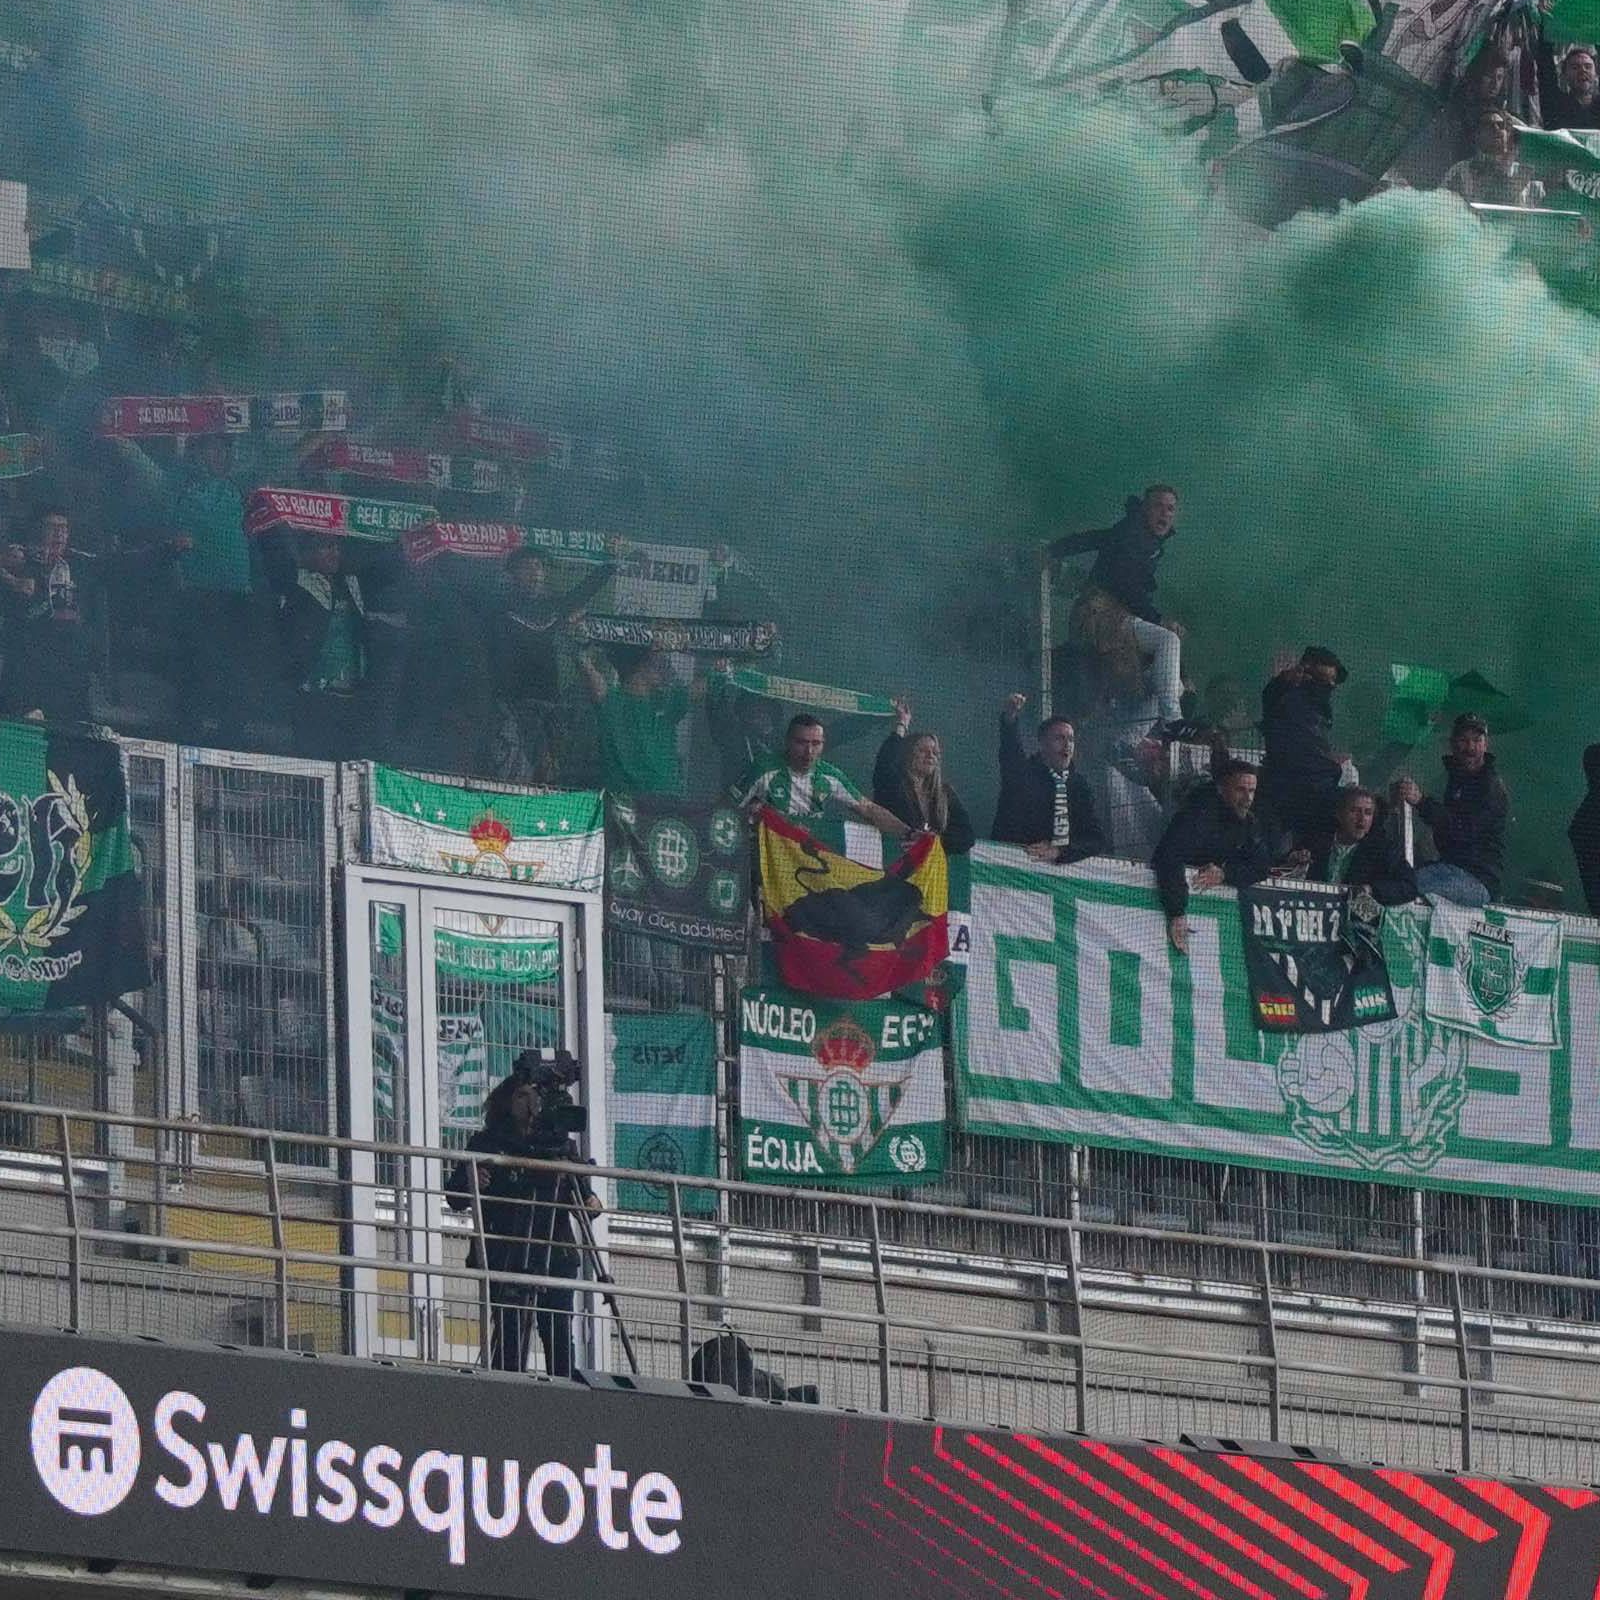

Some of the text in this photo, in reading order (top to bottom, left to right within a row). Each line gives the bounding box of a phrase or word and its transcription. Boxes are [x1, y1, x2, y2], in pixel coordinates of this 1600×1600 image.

[271, 493, 290, 512] SC
[291, 497, 333, 520] BRAGA
[356, 506, 385, 526] REAL
[437, 522, 457, 543] SC
[459, 523, 507, 544] BRAGA
[567, 526, 605, 550] BETIS
[1295, 909, 1327, 943] DEL
[741, 992, 817, 1044] NÚCLEO
[968, 882, 1289, 1111] GOL
[747, 1126, 824, 1174] ÉCIJA
[154, 1390, 683, 1566] Swissquote
